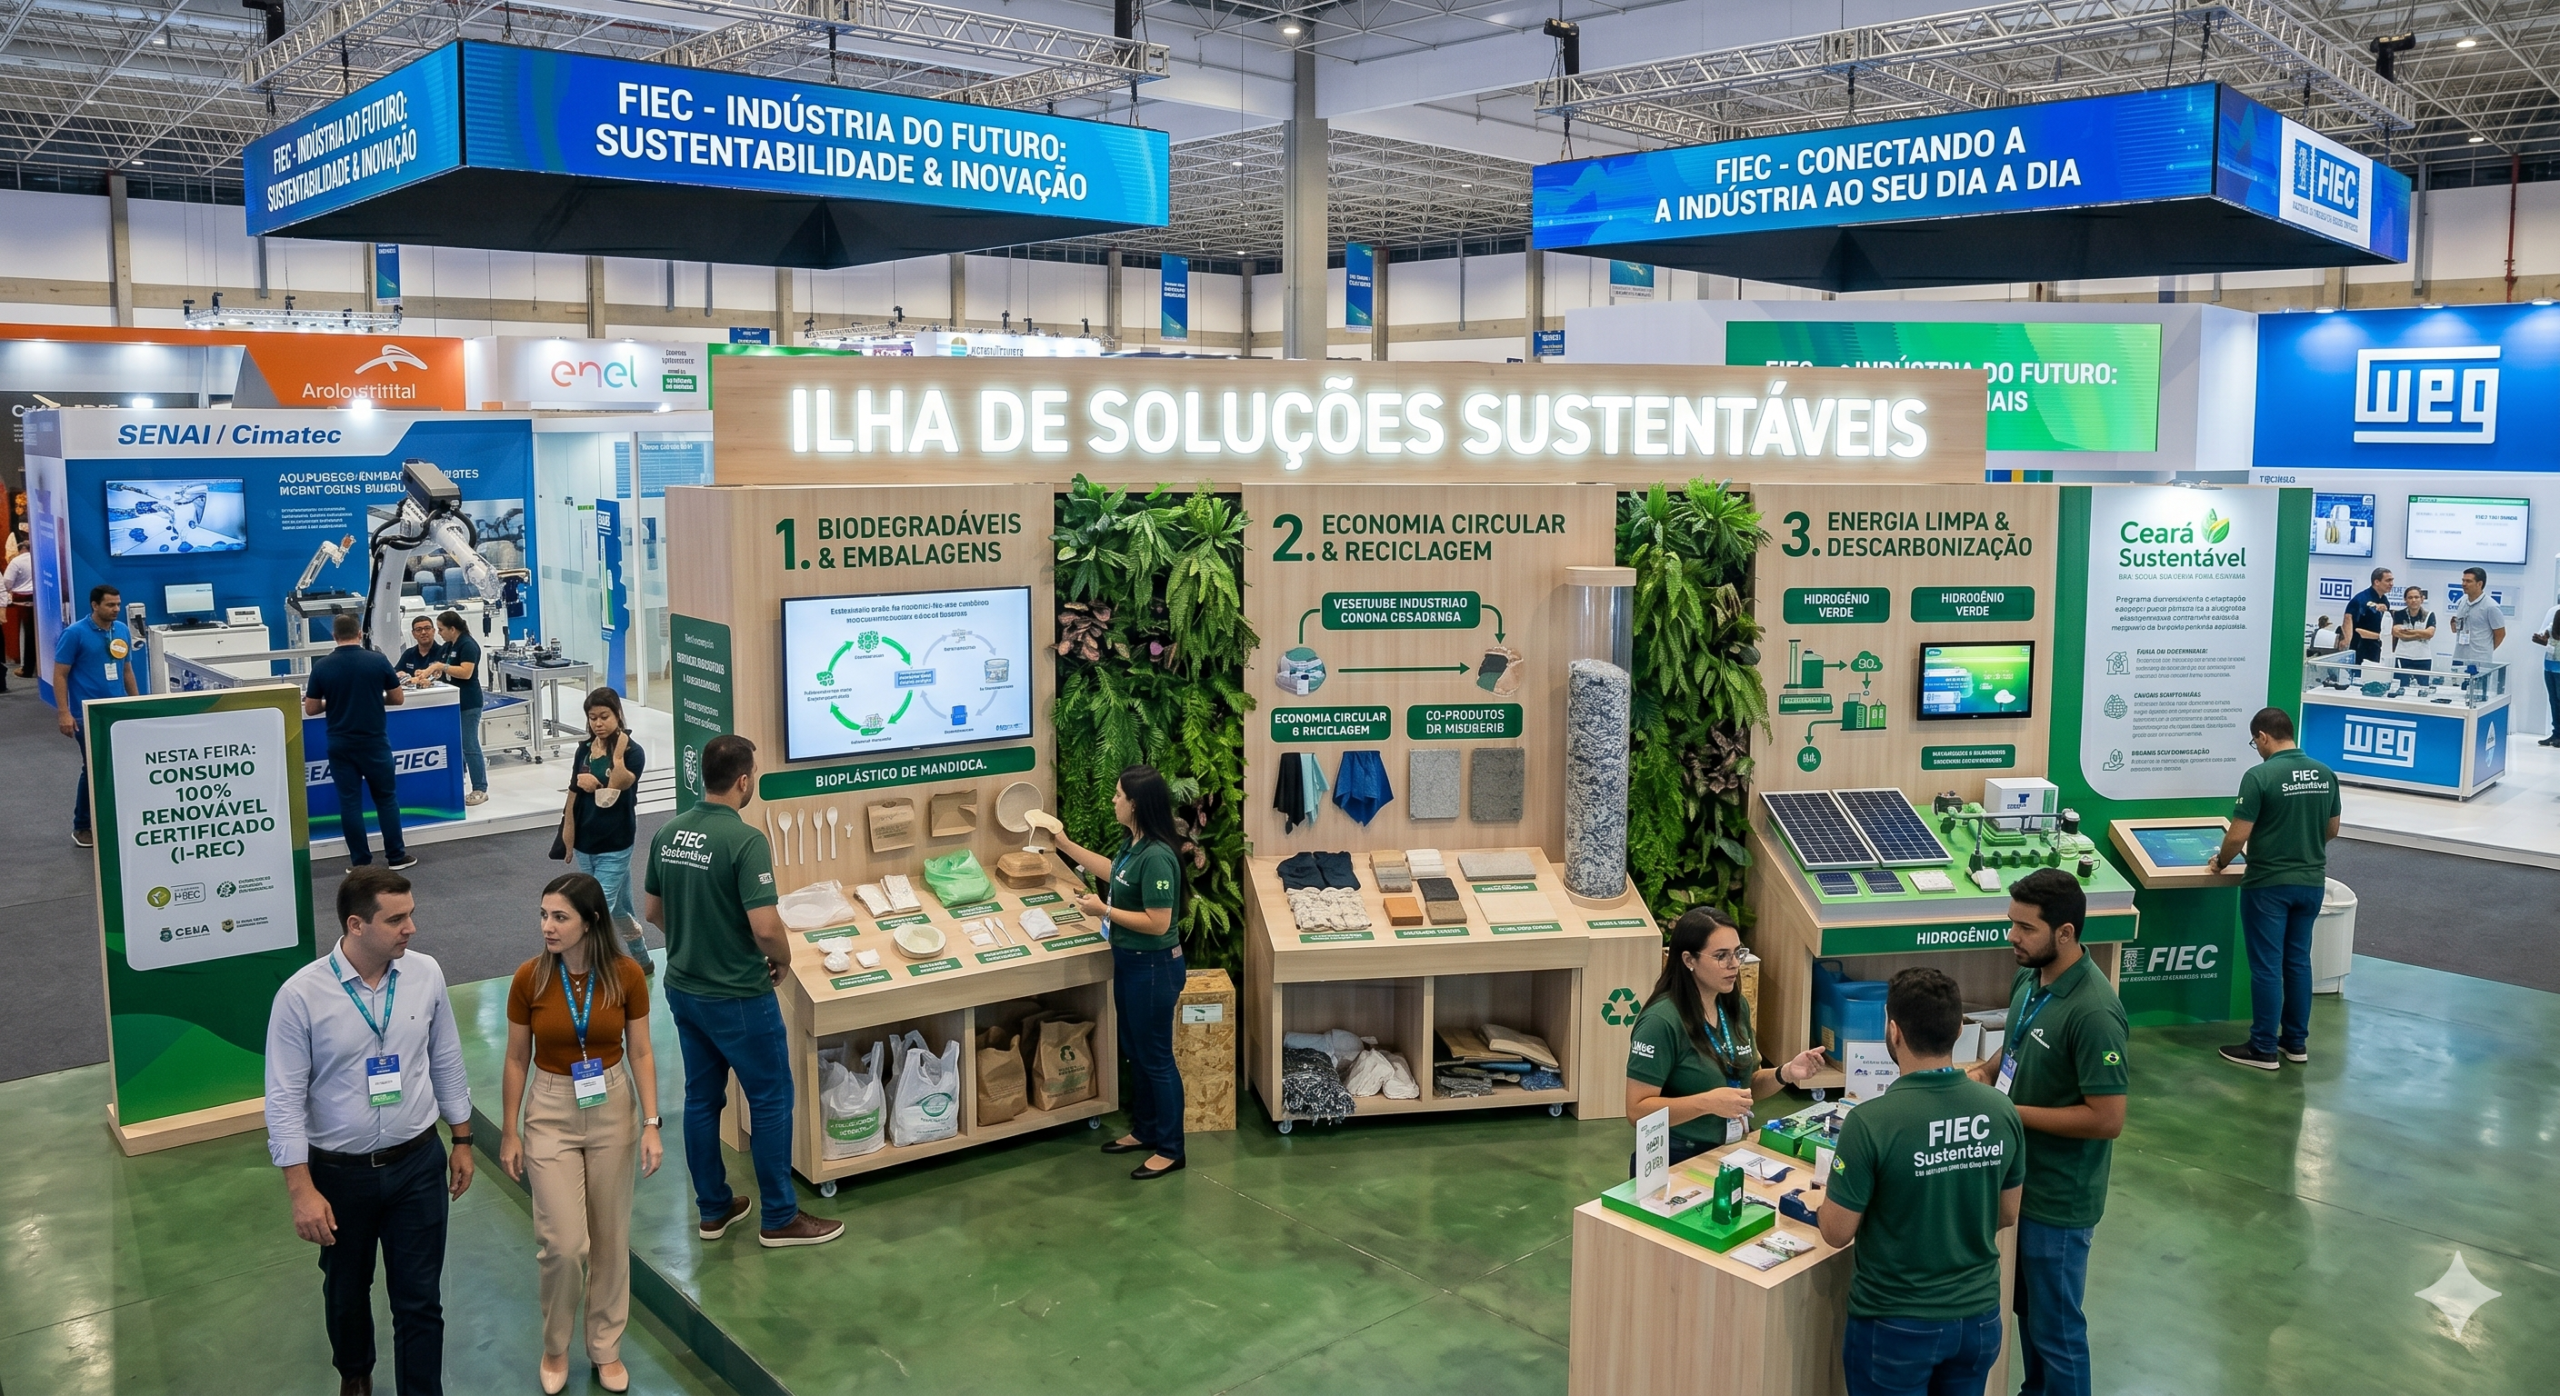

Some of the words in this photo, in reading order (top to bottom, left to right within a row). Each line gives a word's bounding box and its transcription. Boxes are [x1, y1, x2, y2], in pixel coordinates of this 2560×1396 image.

[273, 142, 292, 175] FIEC
[297, 122, 345, 165] INDÚSTRIA
[346, 110, 360, 144] DO
[362, 90, 408, 137] FUTURO:
[618, 81, 694, 122] FIEC
[727, 93, 896, 143] INDÚSTRIA
[903, 115, 944, 148] DO
[952, 122, 1067, 163] FUTURO:
[267, 154, 350, 213] SUSTENTABILIDADE
[352, 151, 360, 181] &
[362, 123, 417, 179] INOVAÇÃO
[596, 123, 915, 185] SUSTENTABILIDADE
[923, 156, 943, 187] &
[952, 160, 1087, 204] INOVAÇÃO
[1716, 154, 1772, 184] FIEC
[1797, 129, 1995, 176] CONECTANDO
[2003, 126, 2026, 156] A
[1654, 198, 1672, 224] A
[1678, 183, 1818, 221] INDÚSTRIA
[1824, 179, 1864, 208] AO
[1871, 172, 1928, 204] SEU
[1937, 167, 1988, 198] DIA
[1995, 164, 2018, 193] A
[2026, 158, 2081, 190] DIA
[2317, 158, 2357, 210] FIEC
[551, 354, 638, 389] enel
[1987, 362, 2014, 384] DO
[2020, 362, 2118, 385] FUTURO:
[117, 424, 211, 446] SENAI
[215, 424, 227, 446] /
[231, 424, 342, 446] Cimatec
[793, 388, 960, 454] ILHA
[980, 389, 1069, 455] DE
[1087, 375, 1445, 472] SOLUÇÕES
[1461, 380, 1928, 458] SUSTENTÁVEIS
[818, 509, 1022, 540] BIODEGRADÁVEIS
[1322, 514, 1446, 535] ECONOMIA
[1452, 513, 1566, 535] CIRCULAR
[1781, 510, 1821, 558] 3.
[1828, 511, 1920, 531] ENERGIA
[1925, 511, 1989, 531] LIMPA
[1994, 511, 2010, 531] &
[2120, 521, 2194, 544] Ceará
[775, 517, 811, 570] 1.
[1272, 513, 1316, 562] 2.
[1321, 541, 1338, 562] &
[1345, 540, 1492, 561] RECICLAGEM
[1827, 533, 2033, 561] DESCARBONIZAÇÃO
[818, 546, 836, 569] &
[843, 541, 1002, 569] EMBALAGENS
[2118, 547, 2247, 568] Sustentável
[1818, 607, 1854, 618] VERDE
[1955, 606, 1990, 617] VERDE
[1274, 713, 1331, 724] ECONOMIA
[1333, 711, 1387, 723] CIRCULAR
[1426, 709, 1505, 722] CO-PRODUTOS
[145, 748, 199, 765] NESTA
[203, 743, 256, 759] FEIRA:
[394, 750, 440, 771] FIEC
[149, 760, 255, 785] CONSUMO
[816, 768, 898, 788] BIOPLÁSTICO
[901, 765, 917, 778] DE
[920, 758, 987, 776] MANDIOCA.
[2292, 769, 2319, 782] FIEC
[175, 782, 232, 803] 100%
[142, 798, 268, 826] RENOVÁVEL
[134, 817, 275, 847] CERTIFICADO
[672, 829, 707, 849] FIEC
[171, 839, 245, 864] (I-REC)
[1916, 926, 2000, 945] HIDROGÊNIO
[2147, 944, 2219, 972] FIEC
[1929, 1114, 1990, 1147] FIEC
[1913, 1140, 2004, 1167] Sustentável
